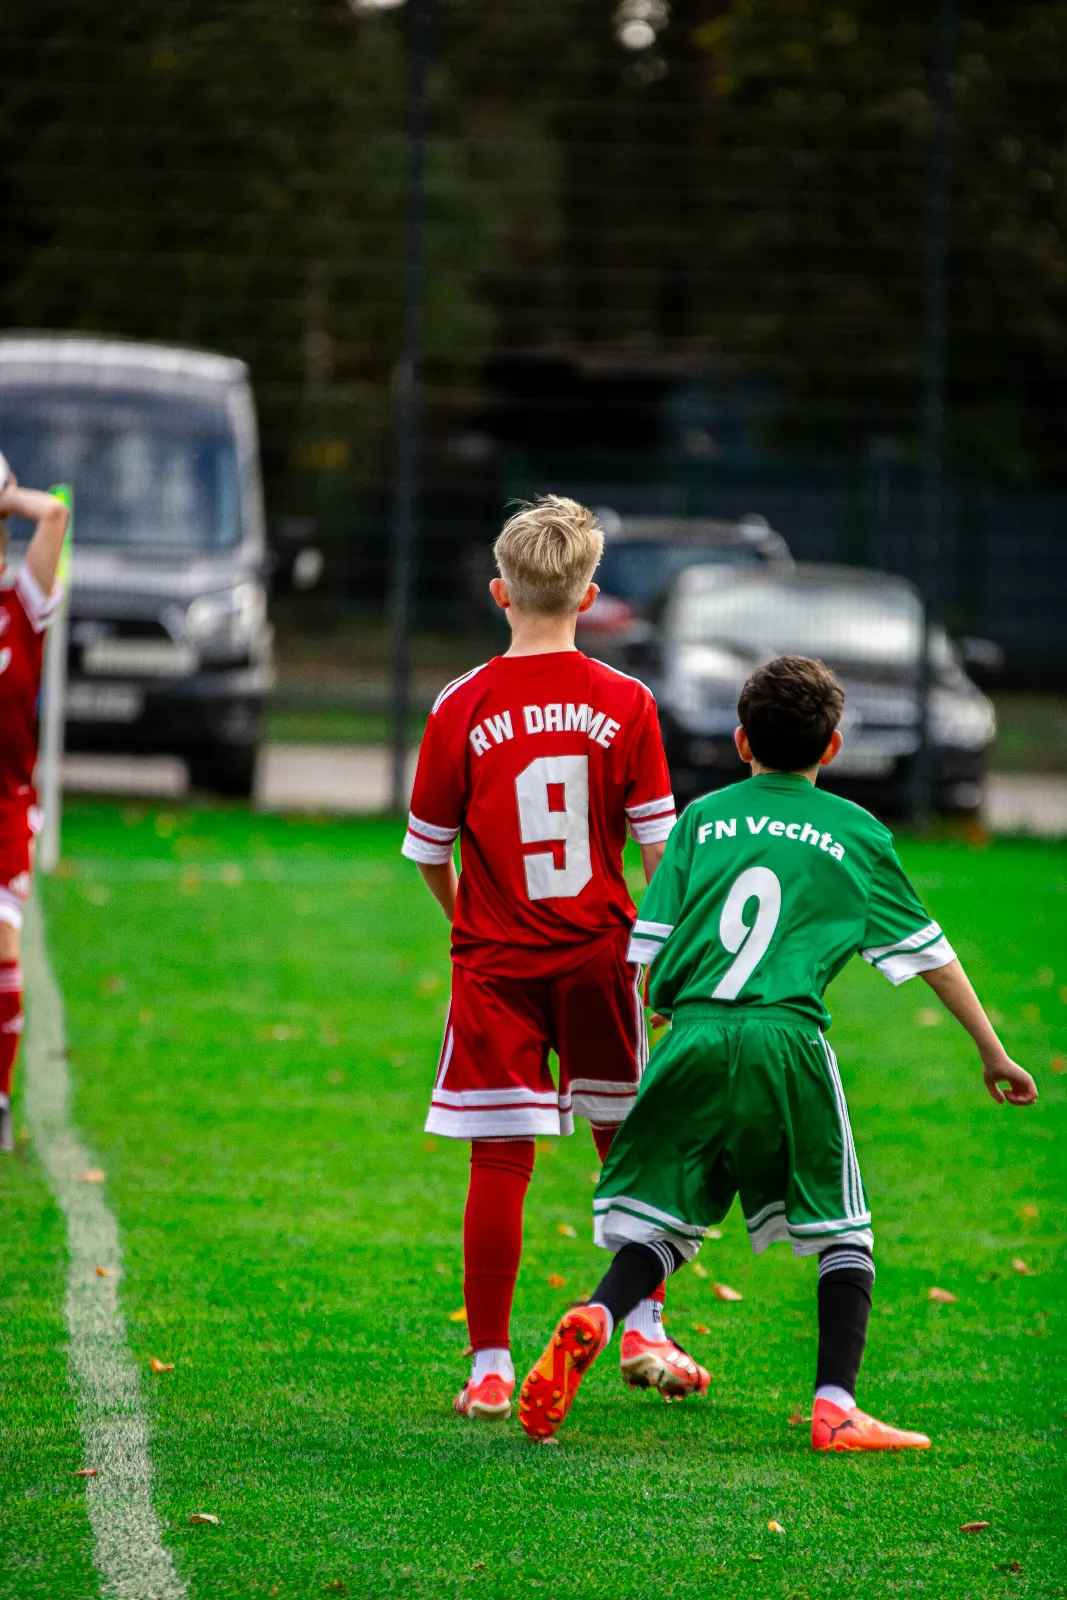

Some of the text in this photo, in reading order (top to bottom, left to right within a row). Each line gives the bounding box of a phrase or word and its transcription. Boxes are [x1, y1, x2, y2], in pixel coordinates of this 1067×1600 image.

[469, 703, 621, 757] RW DAMME
[514, 754, 594, 901] 9
[697, 815, 846, 862] FN Vechta
[711, 866, 782, 1000] 9
